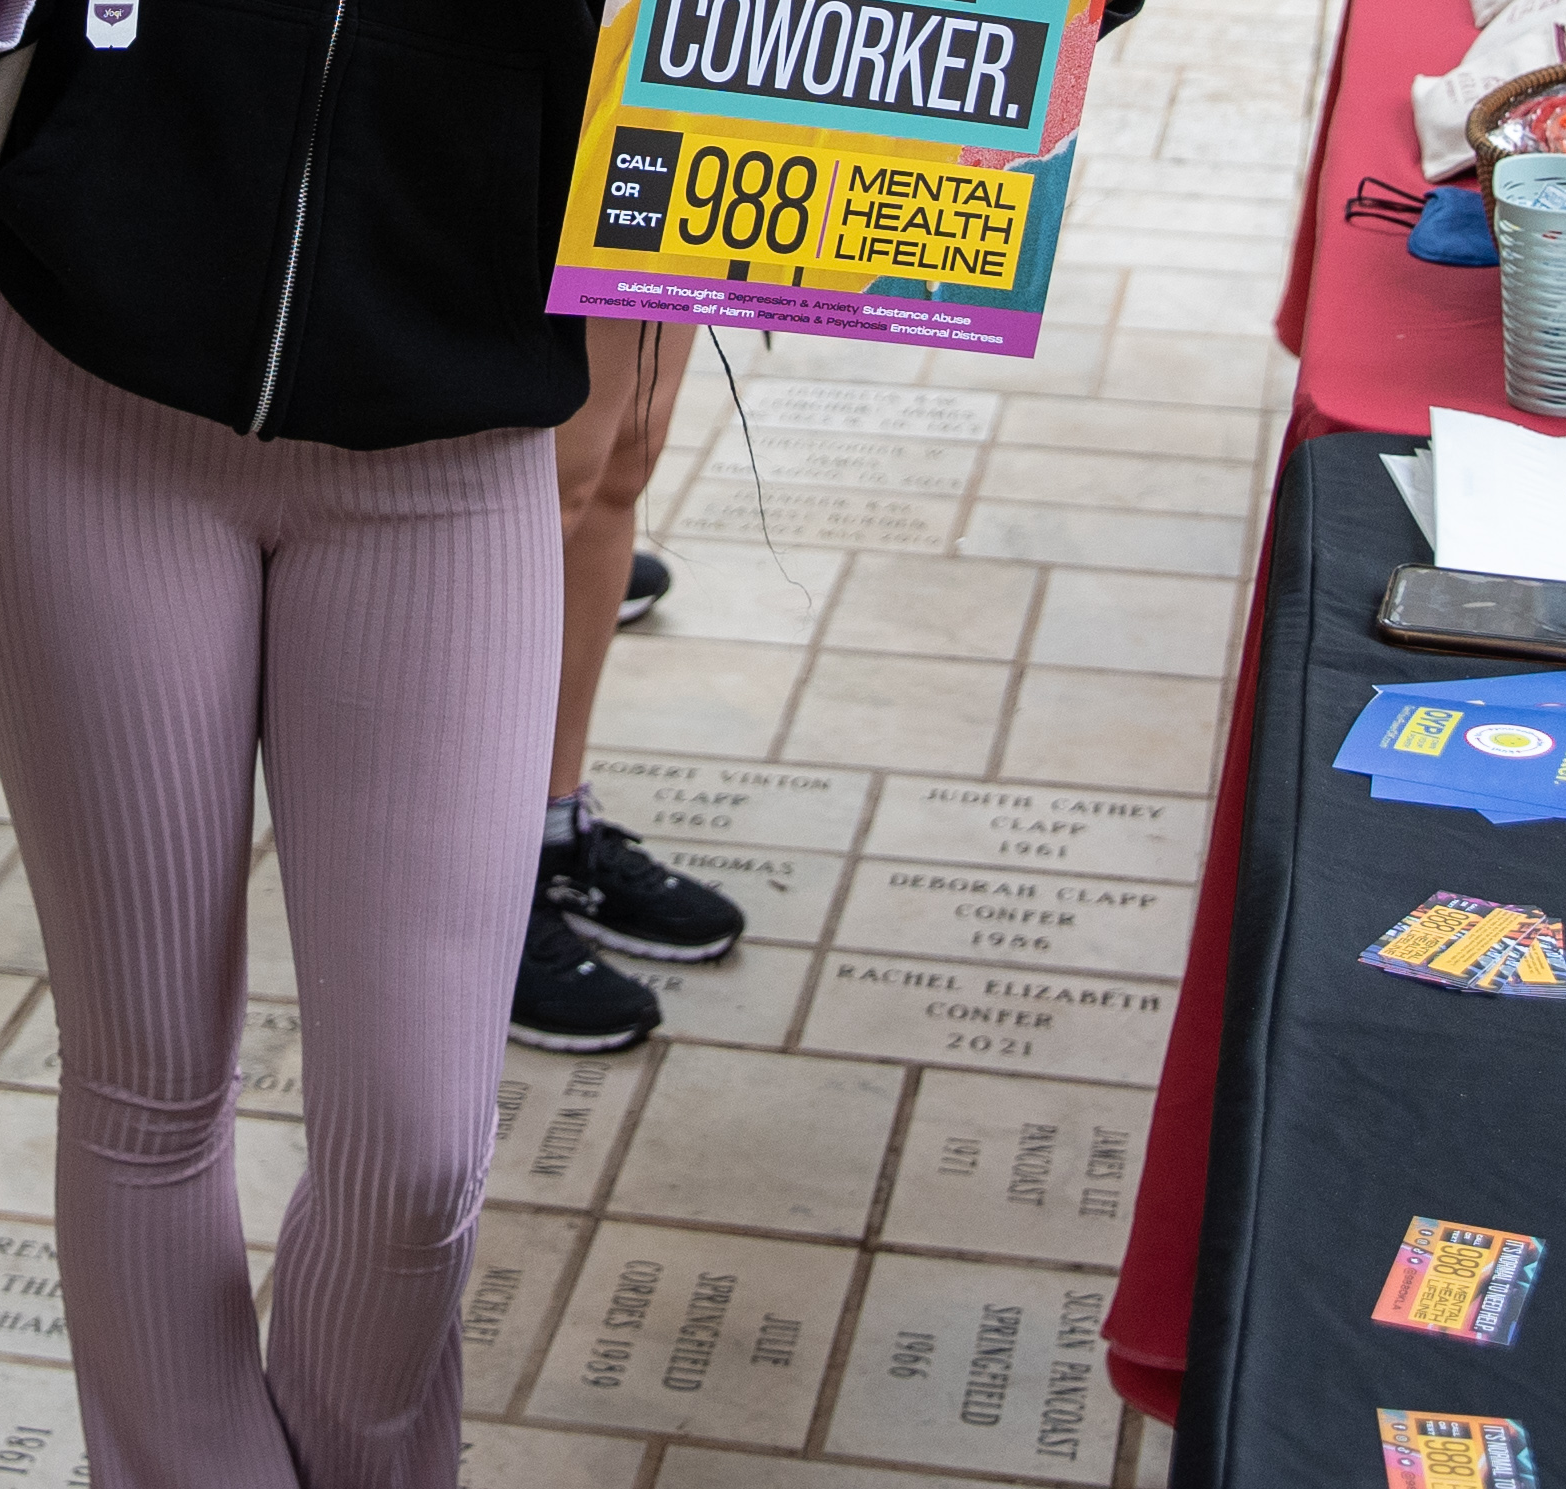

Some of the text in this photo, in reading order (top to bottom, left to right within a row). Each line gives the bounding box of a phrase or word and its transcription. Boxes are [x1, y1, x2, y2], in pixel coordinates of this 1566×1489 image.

[616, 153, 667, 172] CALL
[611, 181, 640, 198] OR
[678, 145, 817, 255] 988
[848, 165, 1016, 211] MENTAL
[606, 209, 662, 228] TEXT
[841, 199, 1013, 245] HEALTH
[834, 234, 1006, 277] LIFELINE
[579, 295, 1003, 344] Domestic Violence Self Harm Paranoia & Psychosis Emotional Distress
[617, 282, 971, 325] Suicidal Thoughts Depression & Anxiety Substance Abuse
[589, 760, 834, 790] ROBERT VINTON
[653, 786, 751, 807] CLAPP
[925, 787, 1166, 819] JUDITH CATHEY
[652, 810, 733, 830] 1960
[989, 815, 1089, 836] CLAPP
[671, 851, 795, 876] THOMAS
[998, 839, 1069, 859] 1961
[888, 872, 1160, 909] DEBORAH CLAPP
[954, 903, 1077, 927] CONFER
[1420, 908, 1470, 933] 988
[969, 930, 1053, 952] 1986
[836, 962, 1163, 1014] RACHEL ELIZABETH
[925, 1001, 1056, 1031] CONFER
[945, 1032, 1035, 1058] 2021
[529, 1108, 592, 1177] WILLIAM
[936, 1136, 981, 1177] 1971
[1085, 1125, 1131, 1180] JAMES
[1006, 1122, 1059, 1207] PANCOAST
[1434, 1245, 1483, 1279] 988
[1492, 1253, 1520, 1281] NORMAL
[1414, 1278, 1439, 1320] LIFELINE
[1428, 1281, 1454, 1323] HEALTH
[1444, 1284, 1470, 1324] MENTAL
[581, 1259, 664, 1389] CORDES 1989
[663, 1271, 738, 1392] SPRINGFIELD
[750, 1313, 803, 1367] JULIE
[888, 1330, 937, 1380] 1966
[960, 1303, 1024, 1427] SPRINGFIELD
[1036, 1290, 1105, 1462] SUSAN PANCOAST
[1425, 1439, 1475, 1477] 988
